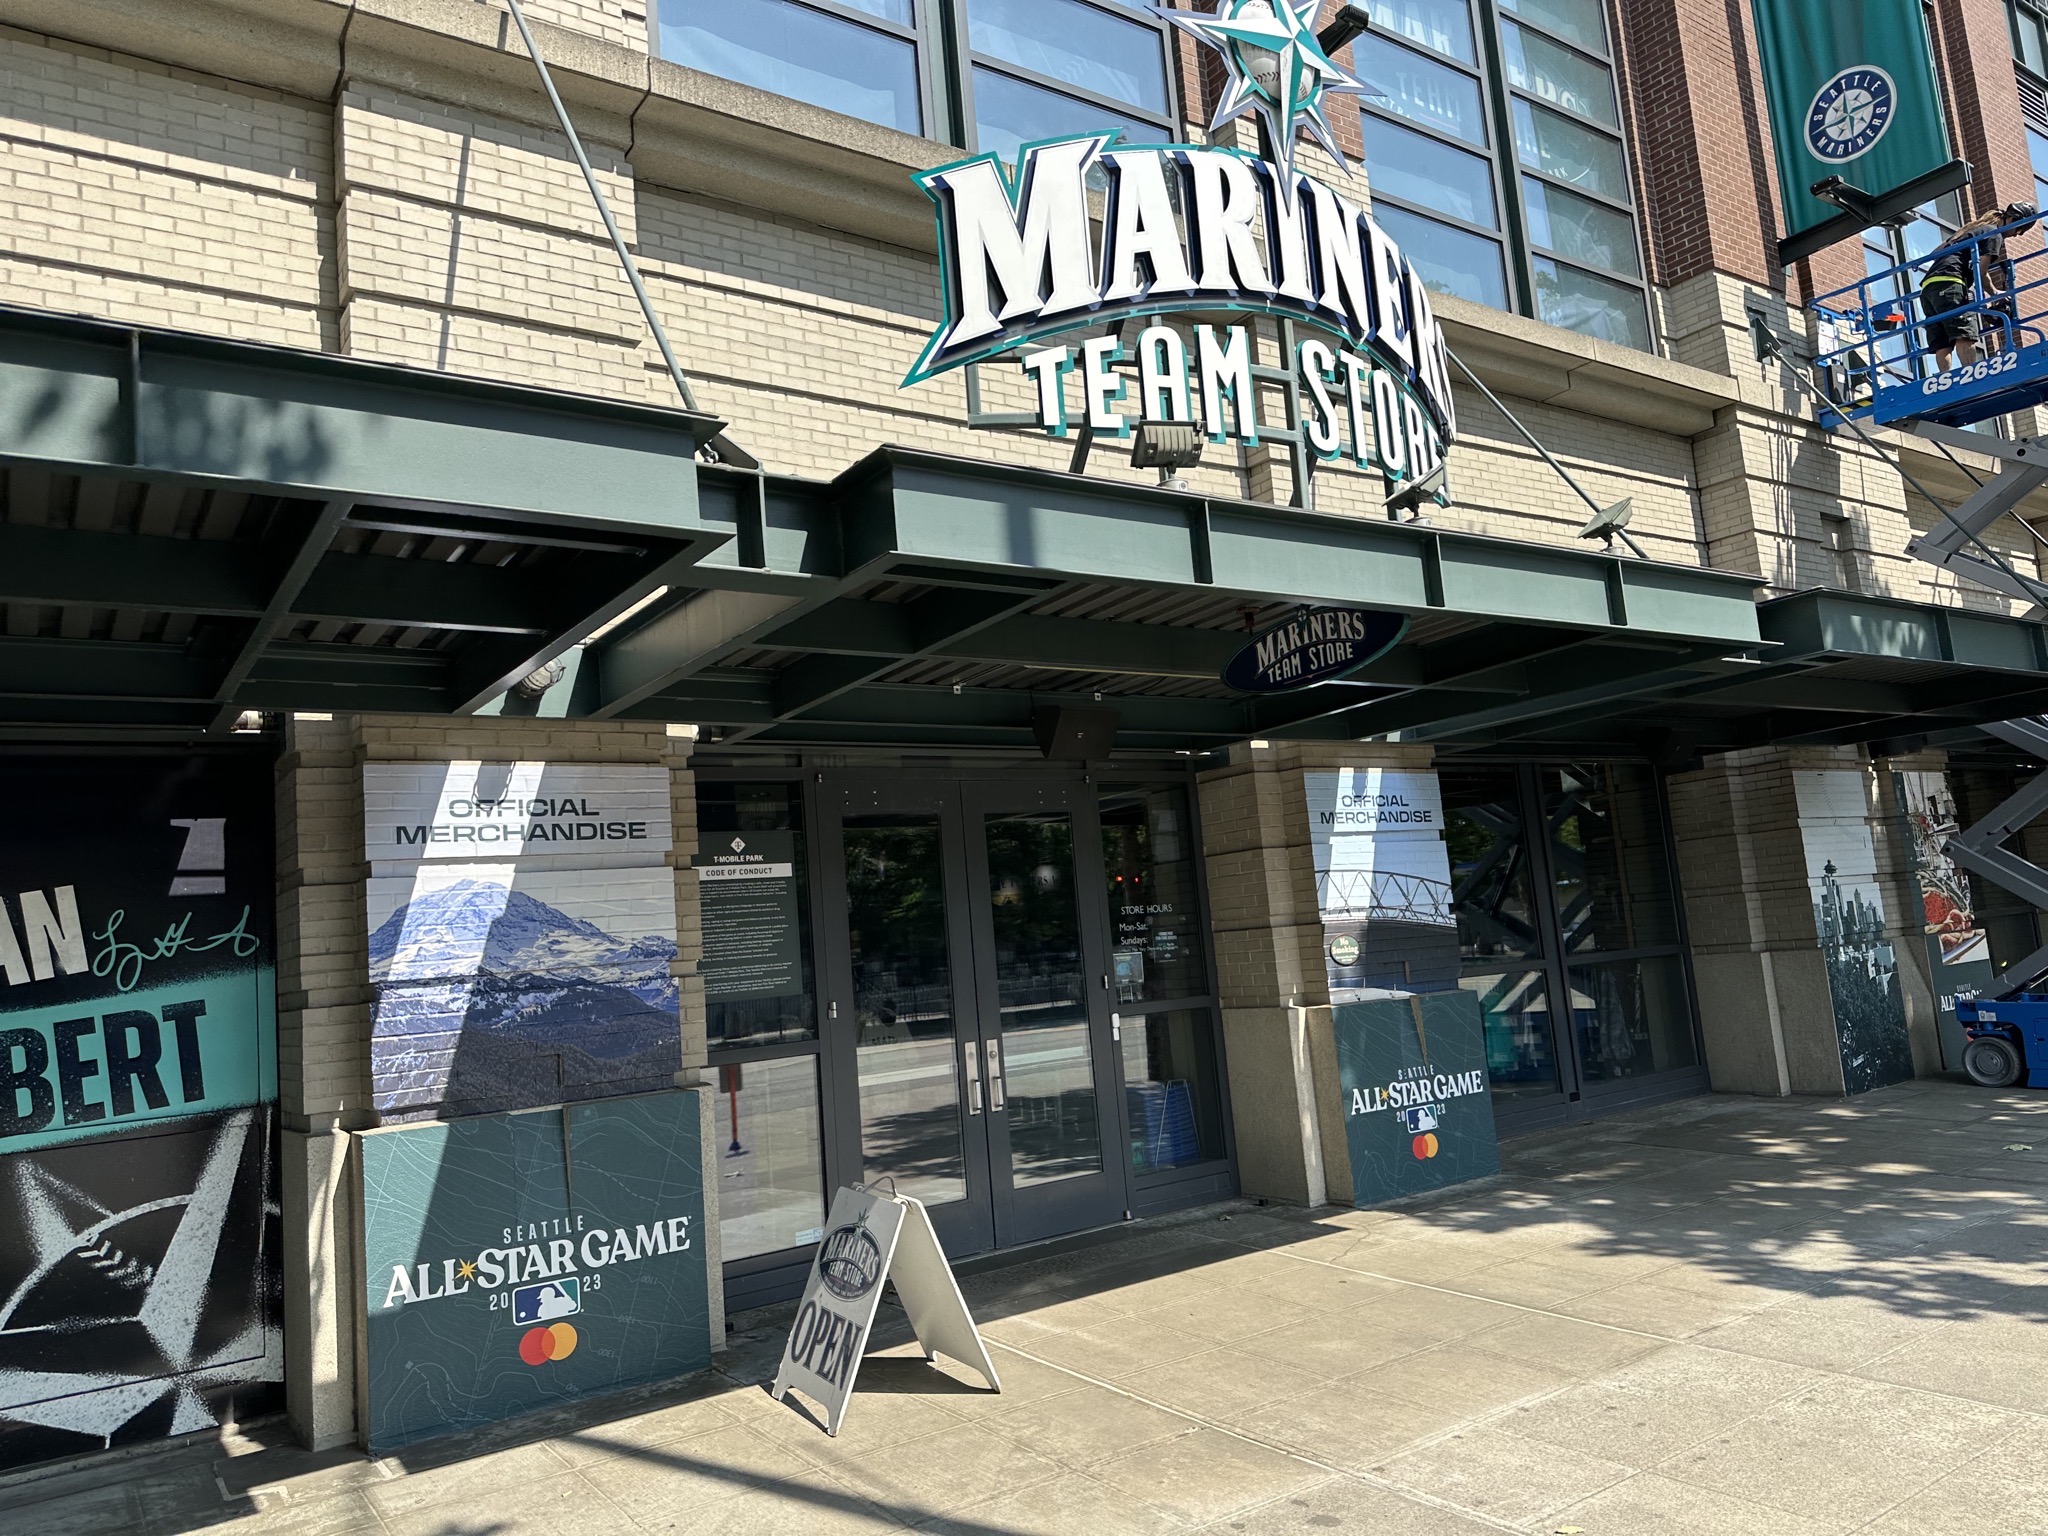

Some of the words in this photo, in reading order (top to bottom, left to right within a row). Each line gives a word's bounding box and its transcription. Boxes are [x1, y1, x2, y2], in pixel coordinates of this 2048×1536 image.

[1813, 75, 1882, 121] SEATTLE
[1817, 106, 1887, 155] MARINERS
[928, 138, 1458, 444] MARINERS
[1023, 325, 1259, 447] TEAM
[1922, 352, 2018, 395] GS-2632
[1255, 611, 1366, 675] MARINERS
[1268, 653, 1301, 683] TEAM
[1309, 642, 1354, 670] STORE
[449, 798, 600, 818] OFFICIAL
[1341, 795, 1409, 808] OFFICIAL
[1320, 811, 1432, 824] MERCHANDISE
[396, 822, 647, 845] MERCHANDISE
[739, 867, 773, 875] CONDUCT
[1121, 905, 1144, 915] STORE
[1147, 904, 1173, 913] HOURS
[1332, 945, 1359, 954] Smoking
[1340, 938, 1349, 946] No
[1351, 1087, 1388, 1115] ALL
[1388, 1079, 1435, 1108] STAR
[1434, 1070, 1483, 1100] GAME
[503, 1215, 585, 1244] SEATTLE
[383, 1259, 470, 1308] ALL
[477, 1239, 578, 1289] STAR
[581, 1216, 691, 1268] GAME
[823, 1232, 880, 1283] MARINERS
[583, 1274, 602, 1292] 23
[828, 1260, 846, 1279] TEAM
[844, 1263, 864, 1287] STORE
[489, 1292, 508, 1311] 20
[791, 1300, 864, 1392] OPEN
